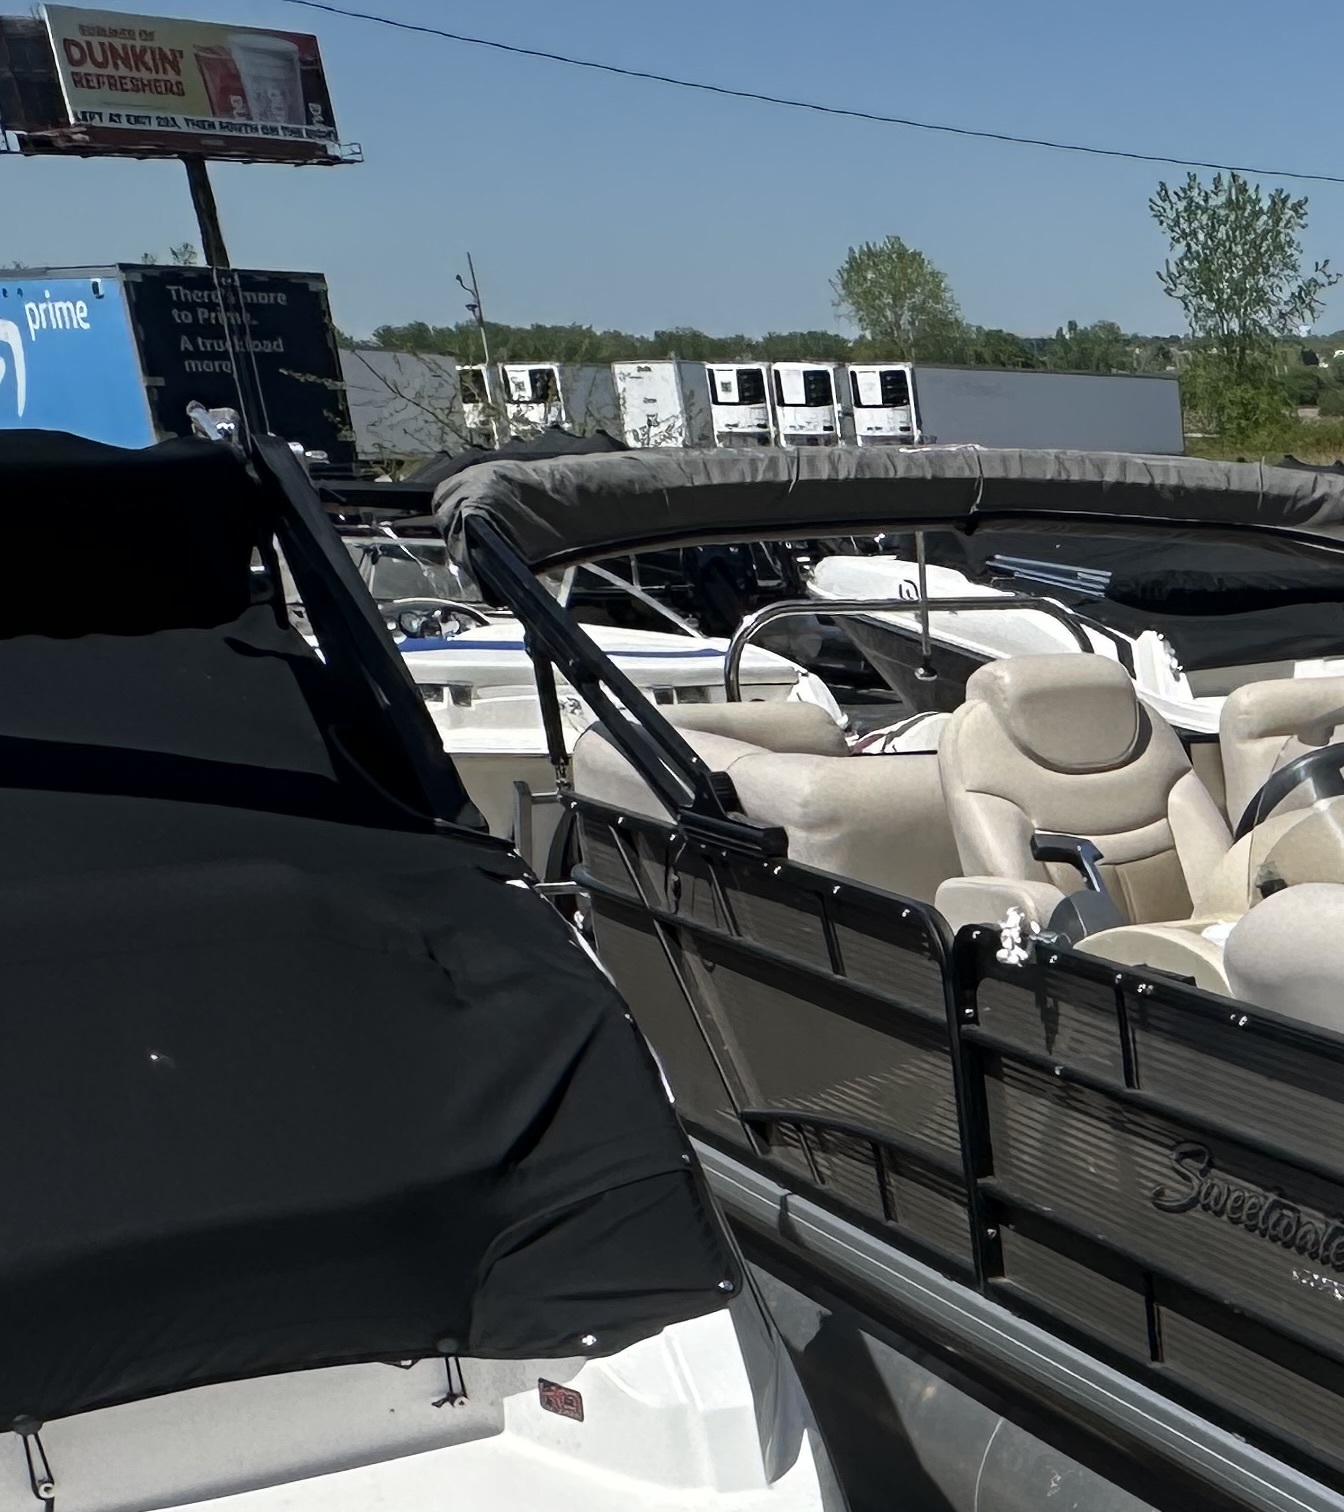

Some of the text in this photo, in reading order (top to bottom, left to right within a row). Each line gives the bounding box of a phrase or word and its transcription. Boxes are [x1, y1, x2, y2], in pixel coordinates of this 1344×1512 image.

[63, 37, 184, 77] DUNKIN'
[71, 71, 186, 97] REFRESHERS
[166, 285, 288, 306] There's more
[24, 289, 91, 342] prime
[171, 308, 193, 324] to
[180, 335, 195, 352] A
